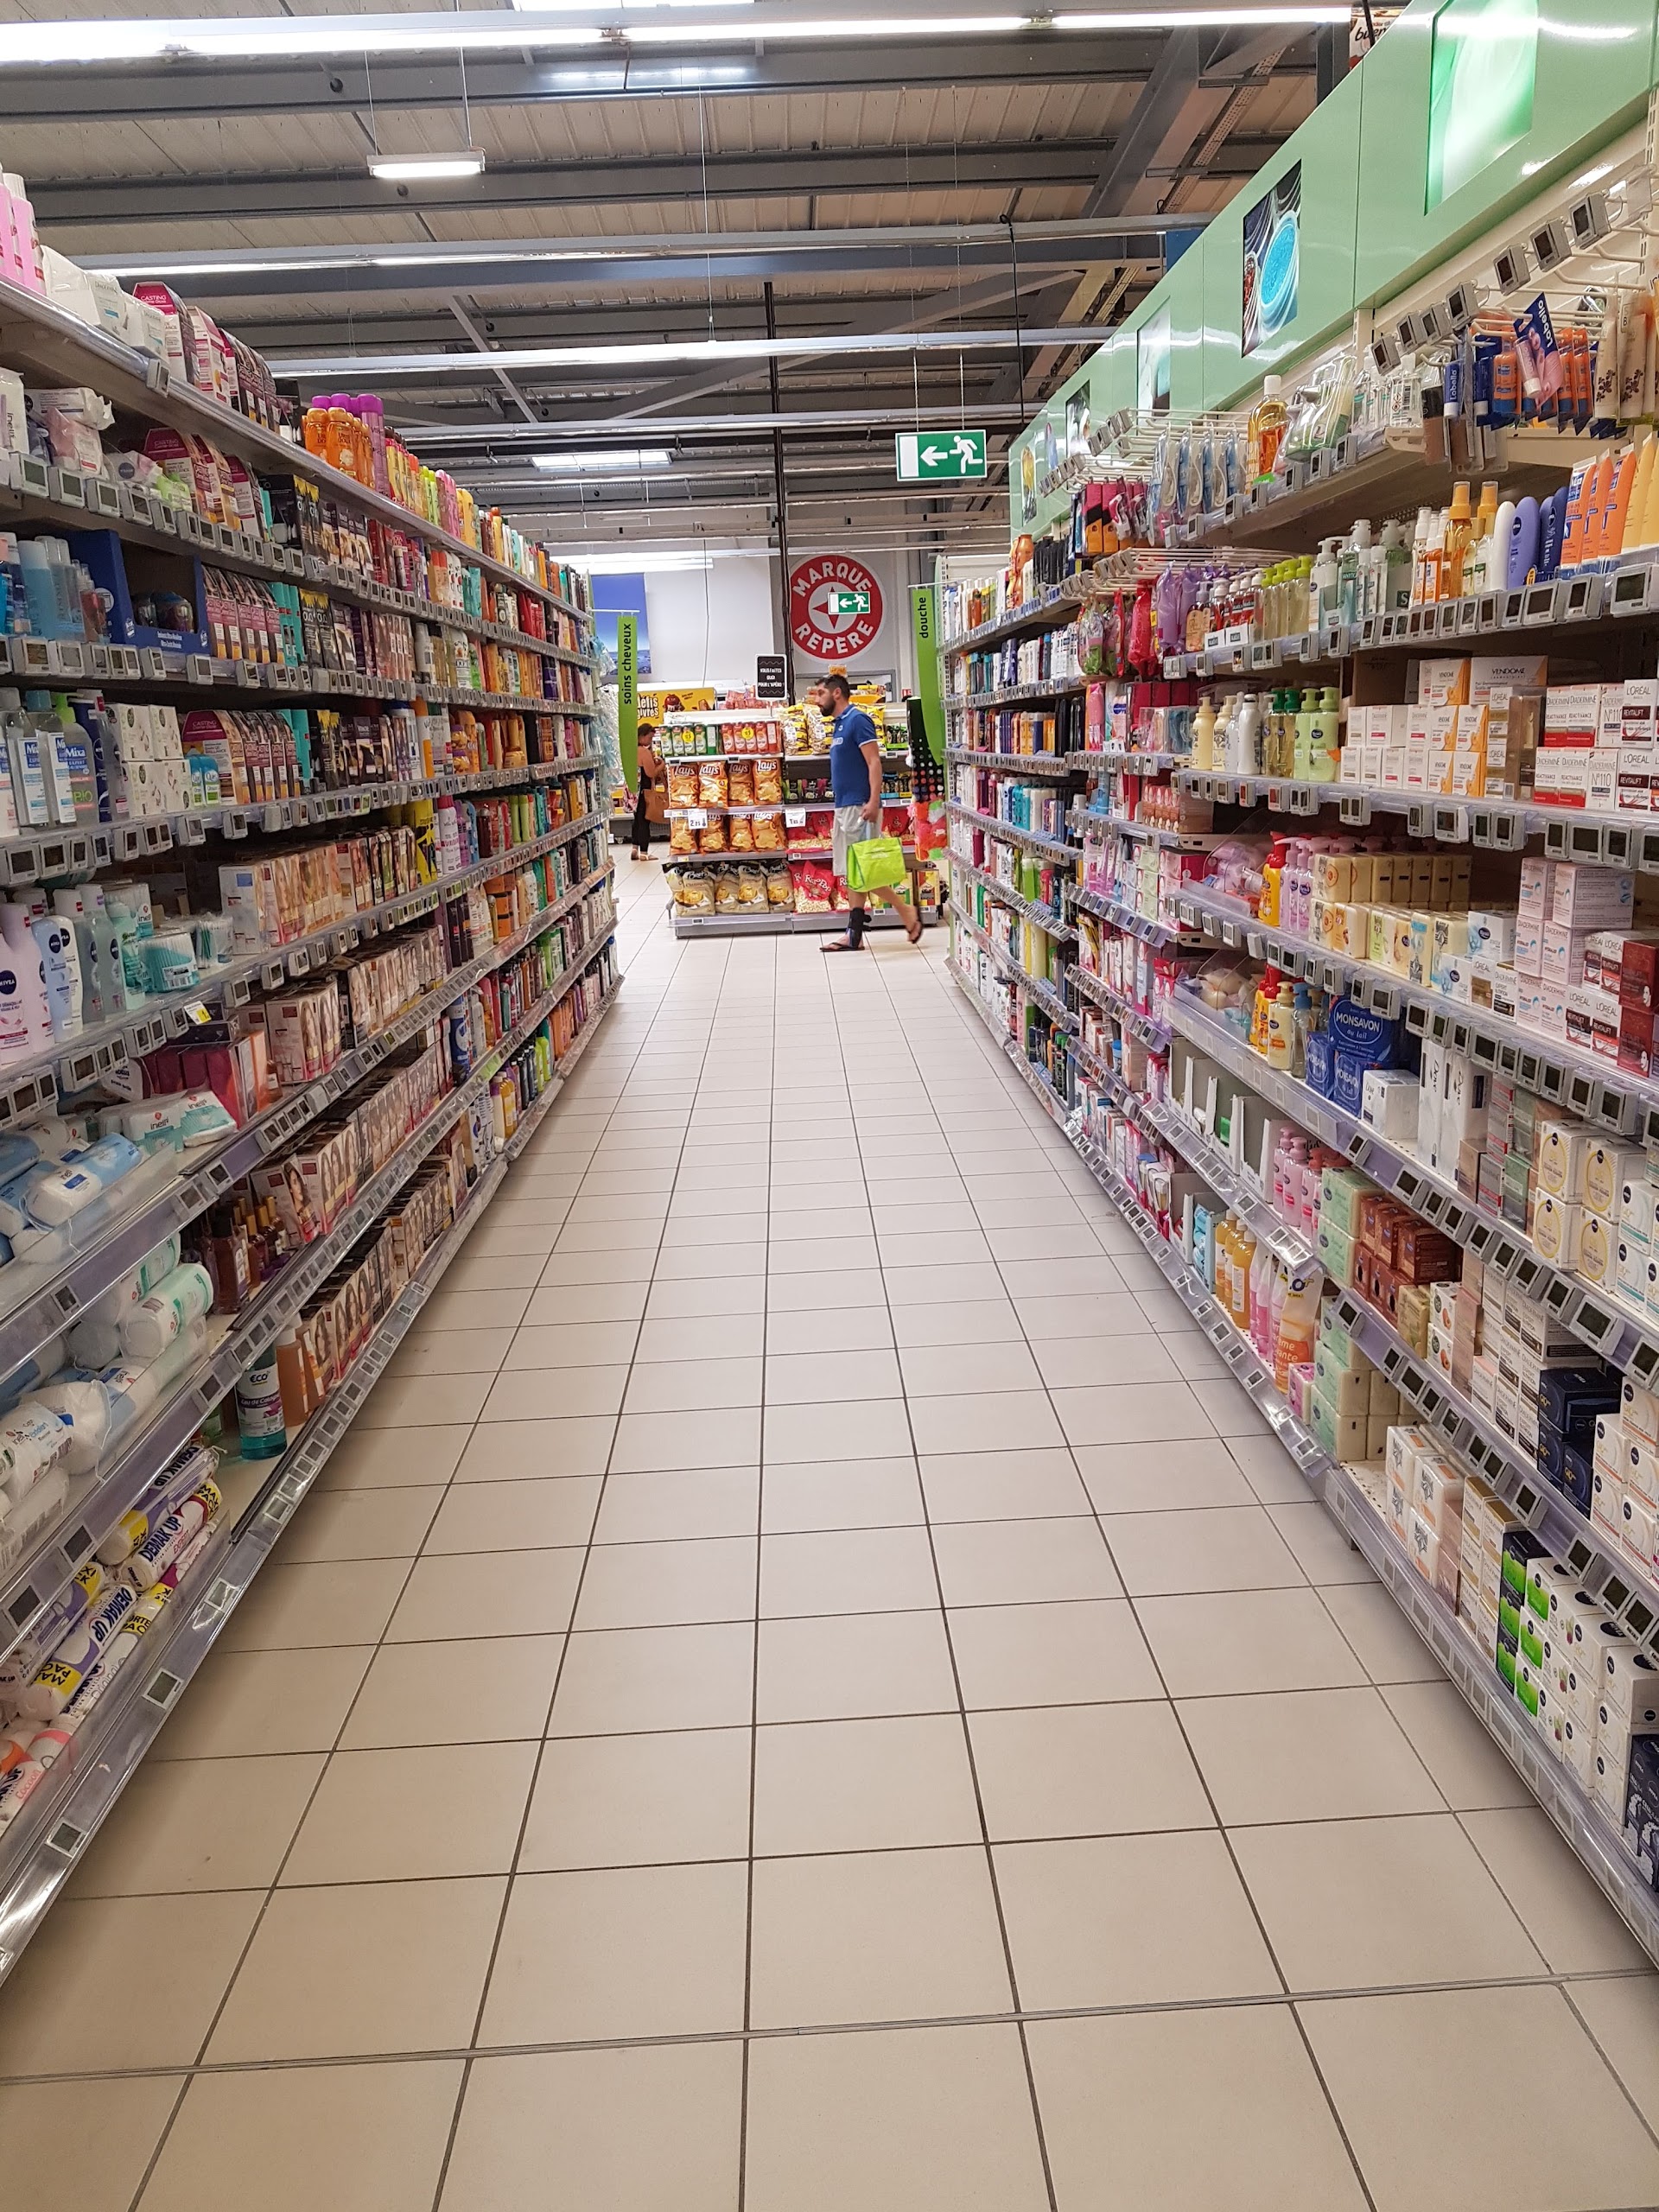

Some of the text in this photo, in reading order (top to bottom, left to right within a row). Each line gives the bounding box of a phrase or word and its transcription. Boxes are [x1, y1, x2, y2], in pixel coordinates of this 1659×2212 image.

[1538, 300, 1554, 348] Labello
[792, 562, 872, 597] MARQUE
[918, 597, 928, 638] douche
[795, 620, 874, 654] REPÈRE
[621, 623, 632, 704] soins cheveux
[1492, 667, 1525, 676] VENDOME
[66, 747, 86, 757] Mixa
[1337, 1015, 1380, 1033] MONSAVON
[138, 1527, 173, 1563] DEMAK
[165, 1516, 182, 1532] UP
[92, 1586, 133, 1643] DEMAK UP
